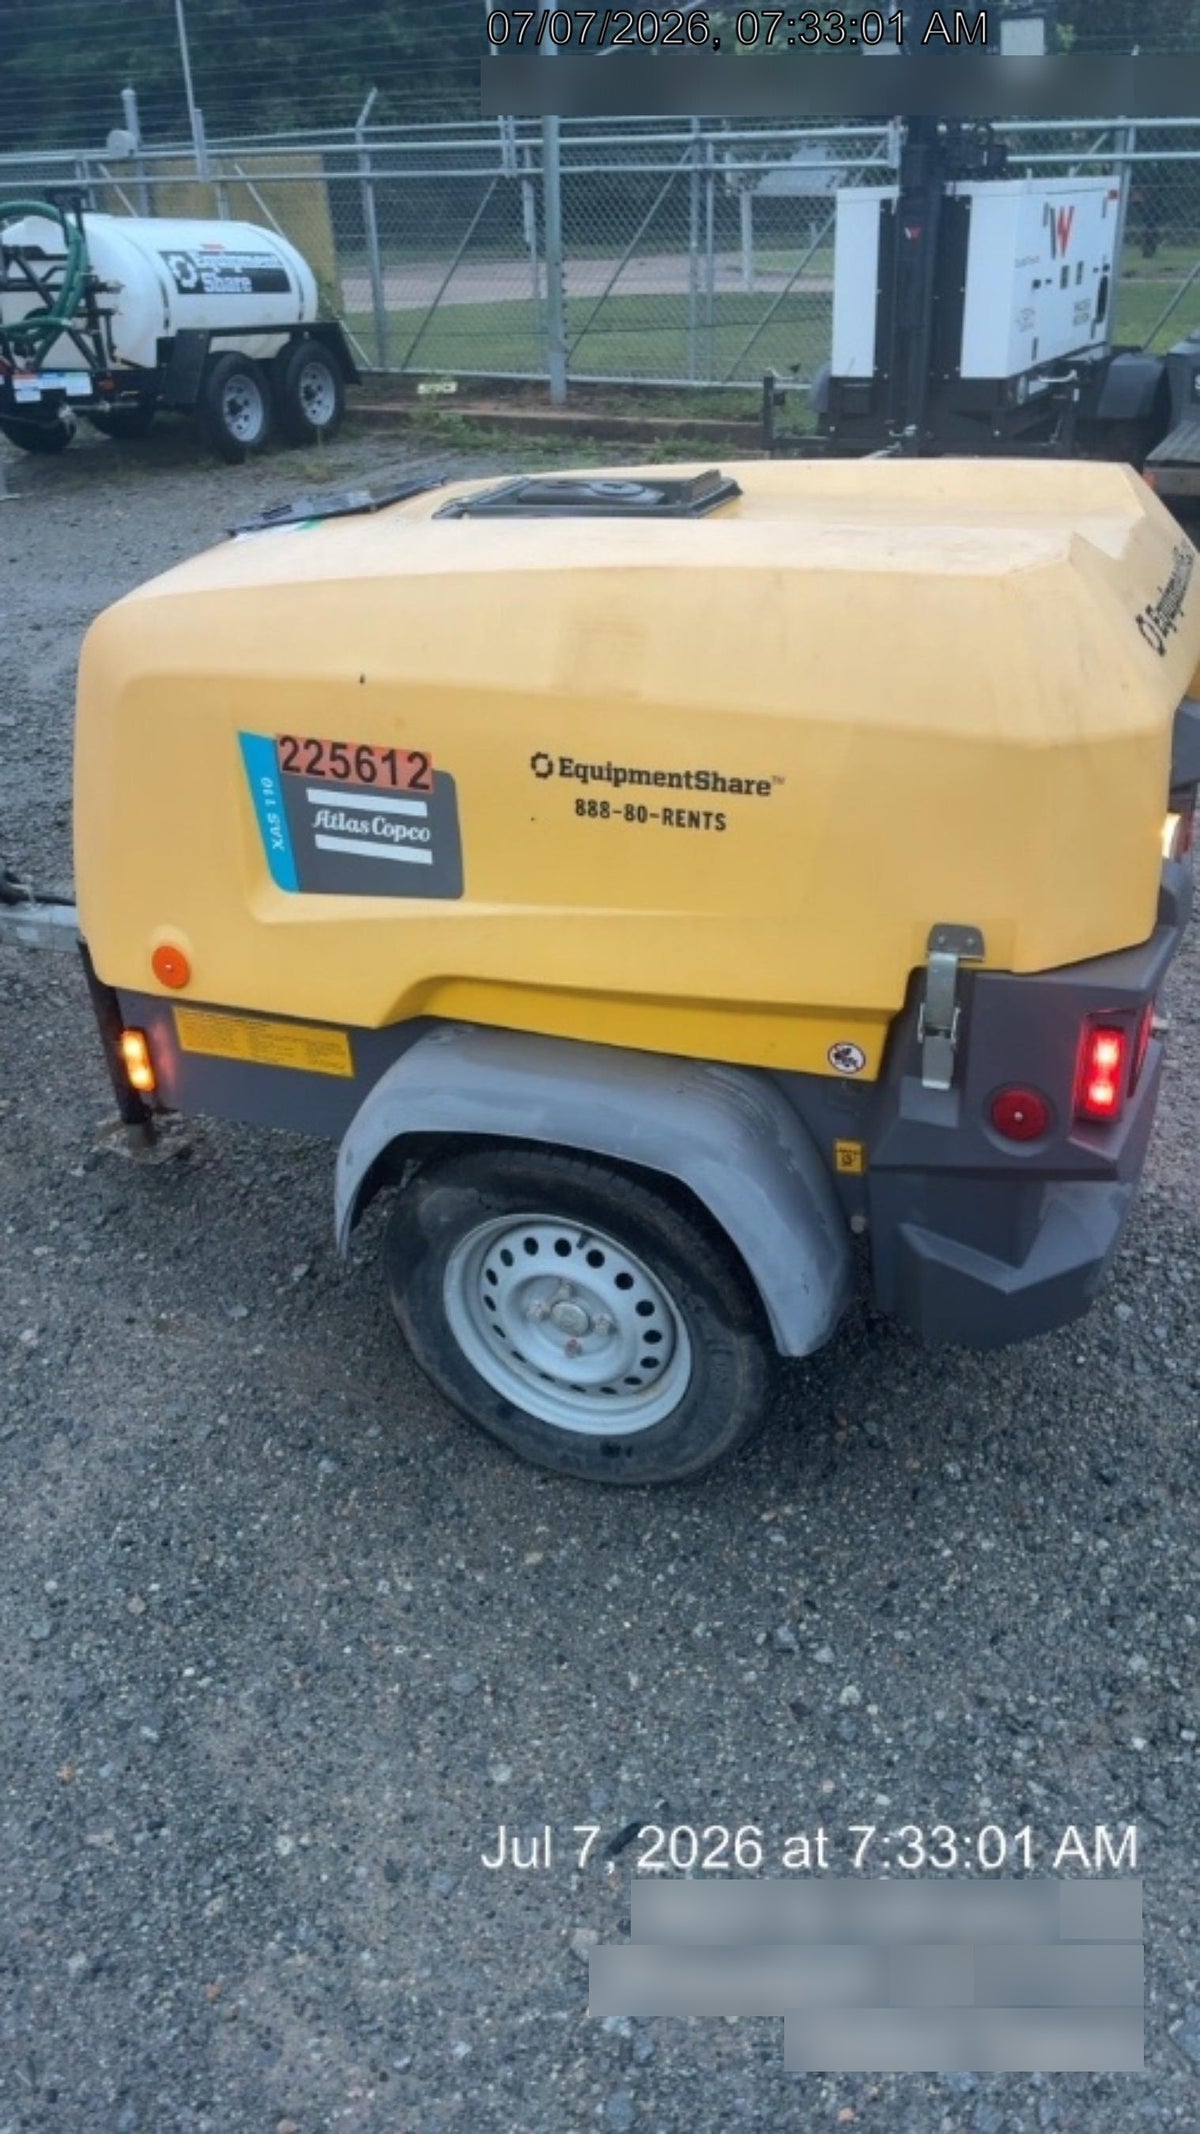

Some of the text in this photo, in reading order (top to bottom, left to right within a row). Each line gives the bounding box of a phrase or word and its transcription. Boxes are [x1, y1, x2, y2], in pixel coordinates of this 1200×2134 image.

[279, 735, 431, 790] 225612
[267, 812, 285, 852] XAS
[313, 809, 431, 843] Atlas Copco
[574, 798, 727, 832] 888-80-RENTS
